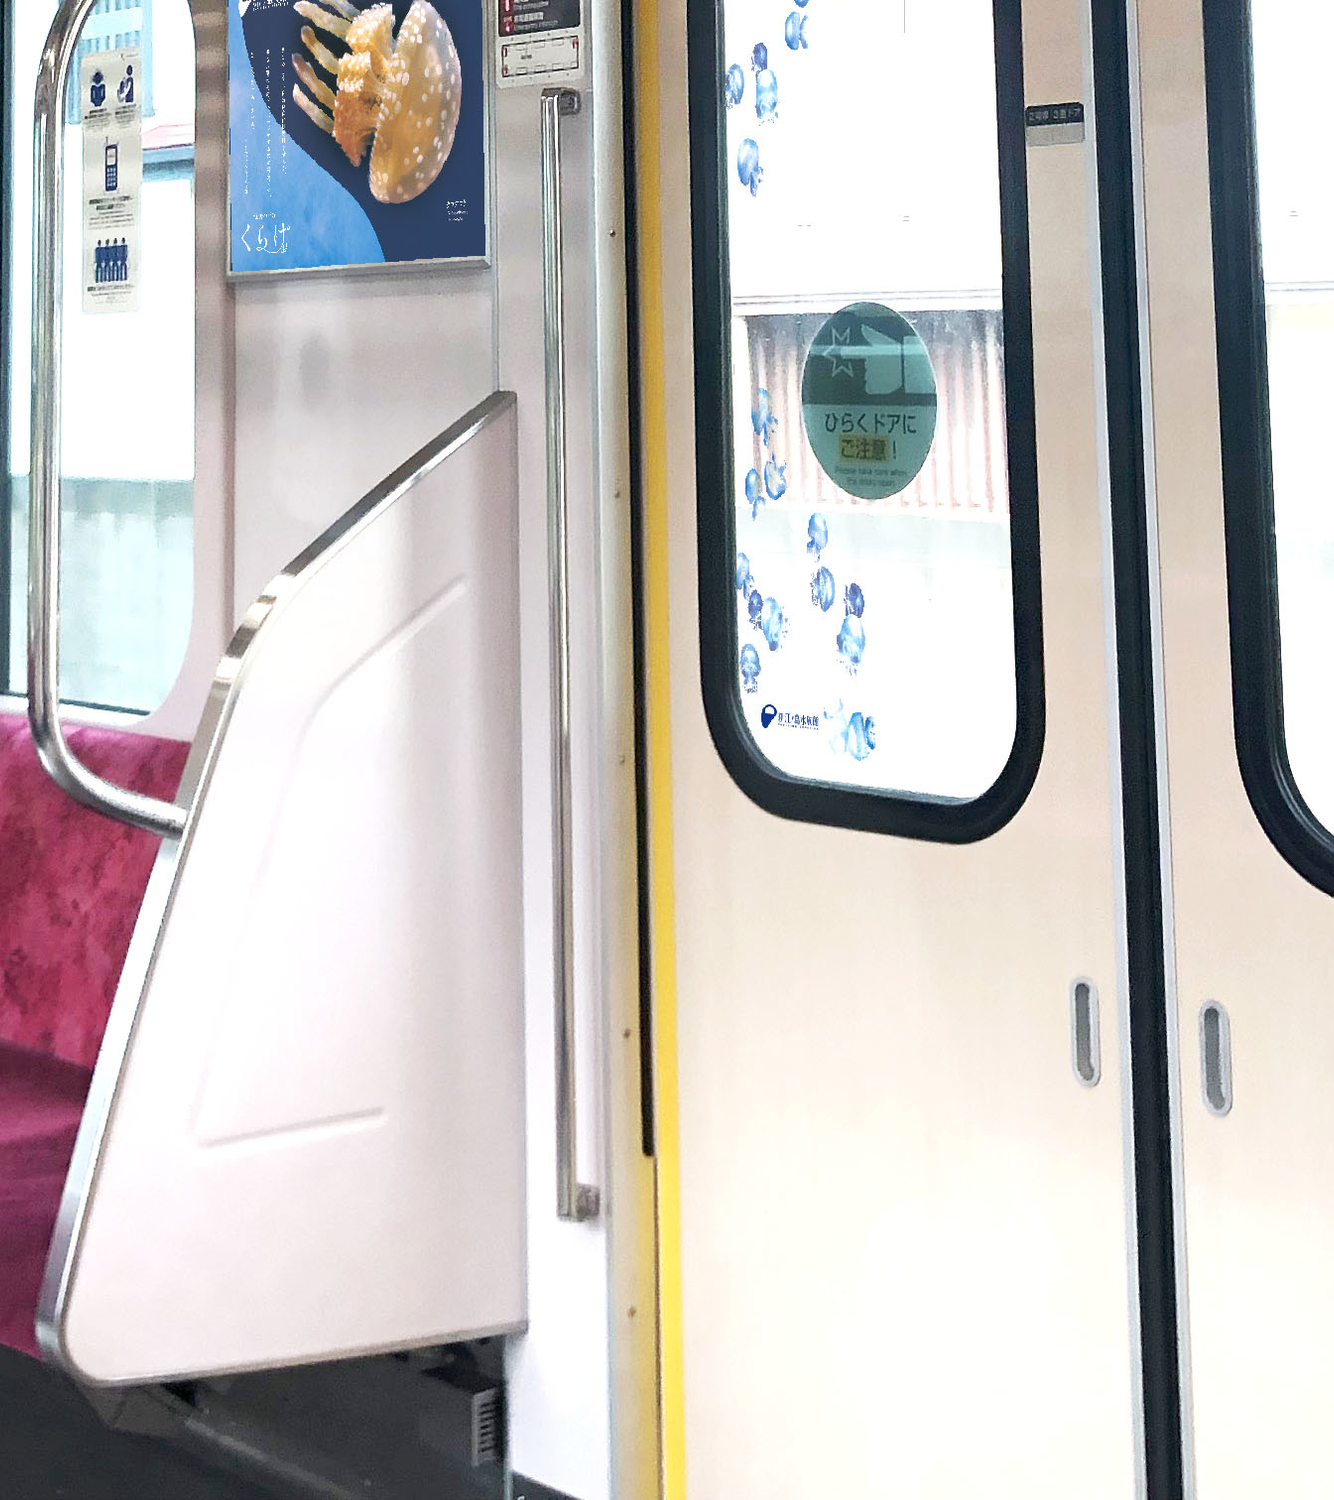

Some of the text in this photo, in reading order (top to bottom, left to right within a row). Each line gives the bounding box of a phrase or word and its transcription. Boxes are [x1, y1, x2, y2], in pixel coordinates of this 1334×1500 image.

[825, 412, 917, 435] ひらくドアに
